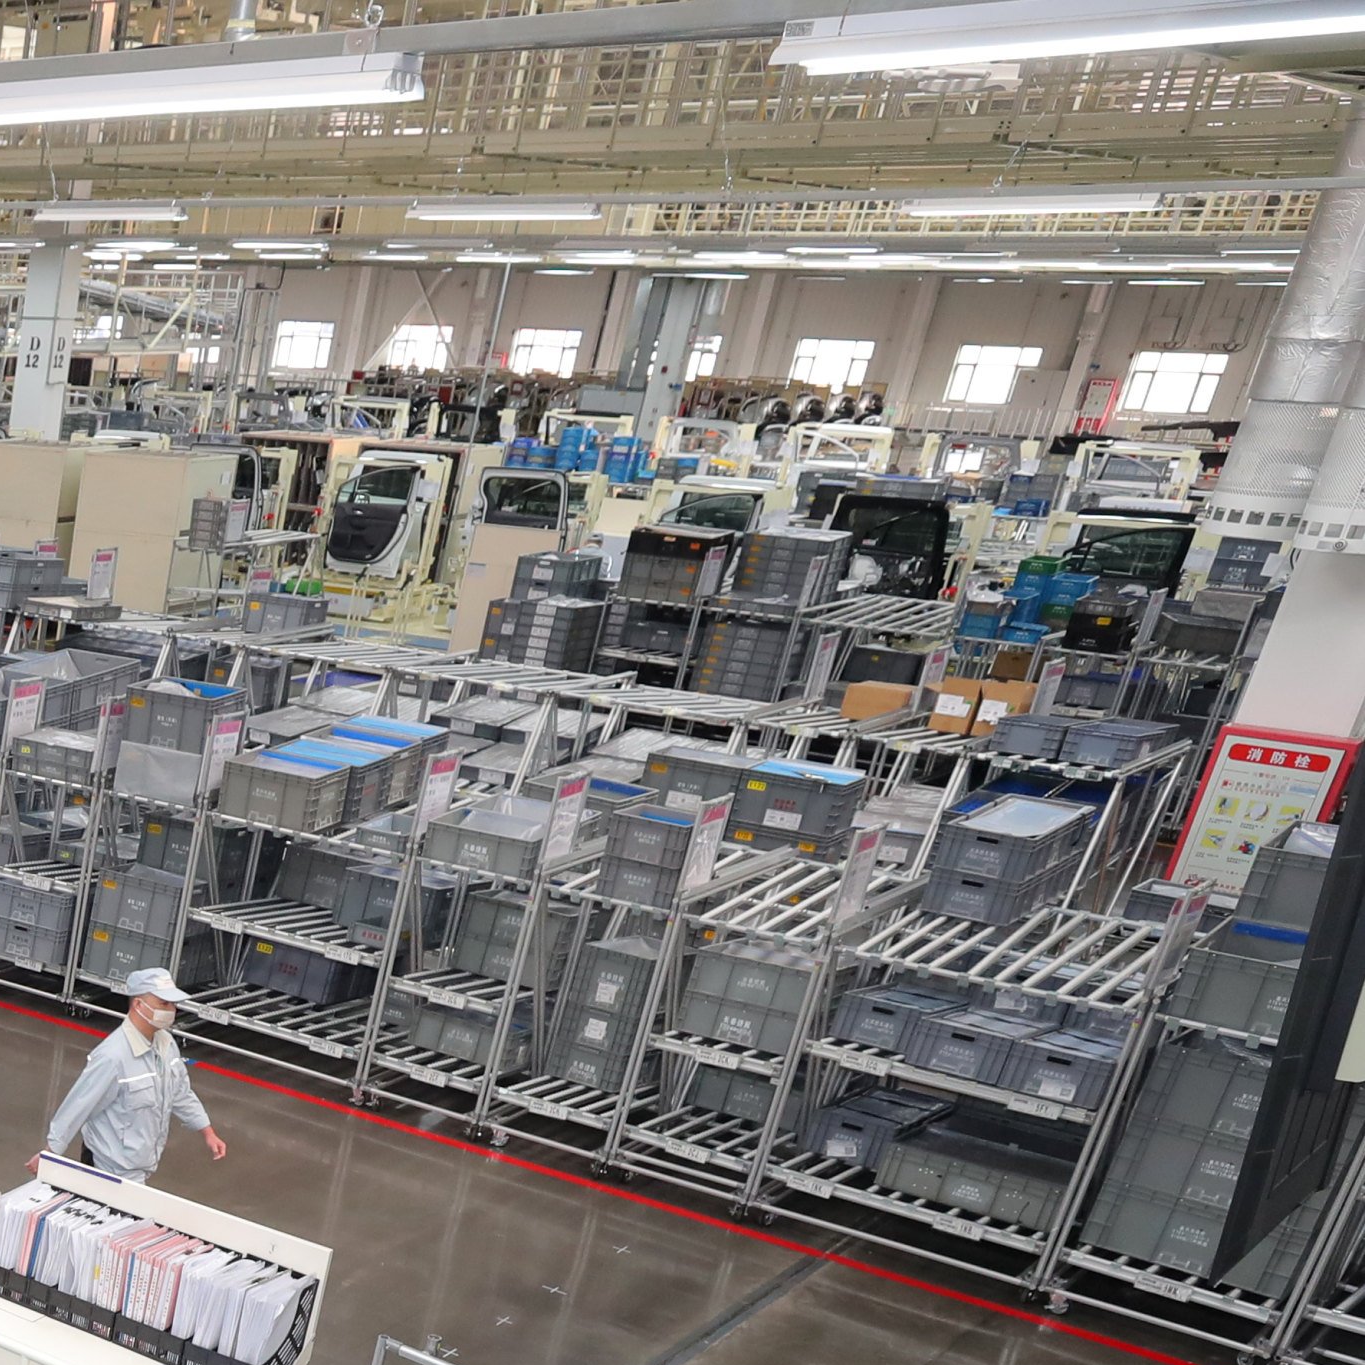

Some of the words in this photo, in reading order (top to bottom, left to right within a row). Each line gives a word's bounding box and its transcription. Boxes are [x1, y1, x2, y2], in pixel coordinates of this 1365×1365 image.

[29, 336, 41, 351] D
[57, 336, 66, 351] D
[24, 354, 39, 368] 12
[53, 354, 64, 368] 12
[1246, 747, 1312, 769] 消防栓
